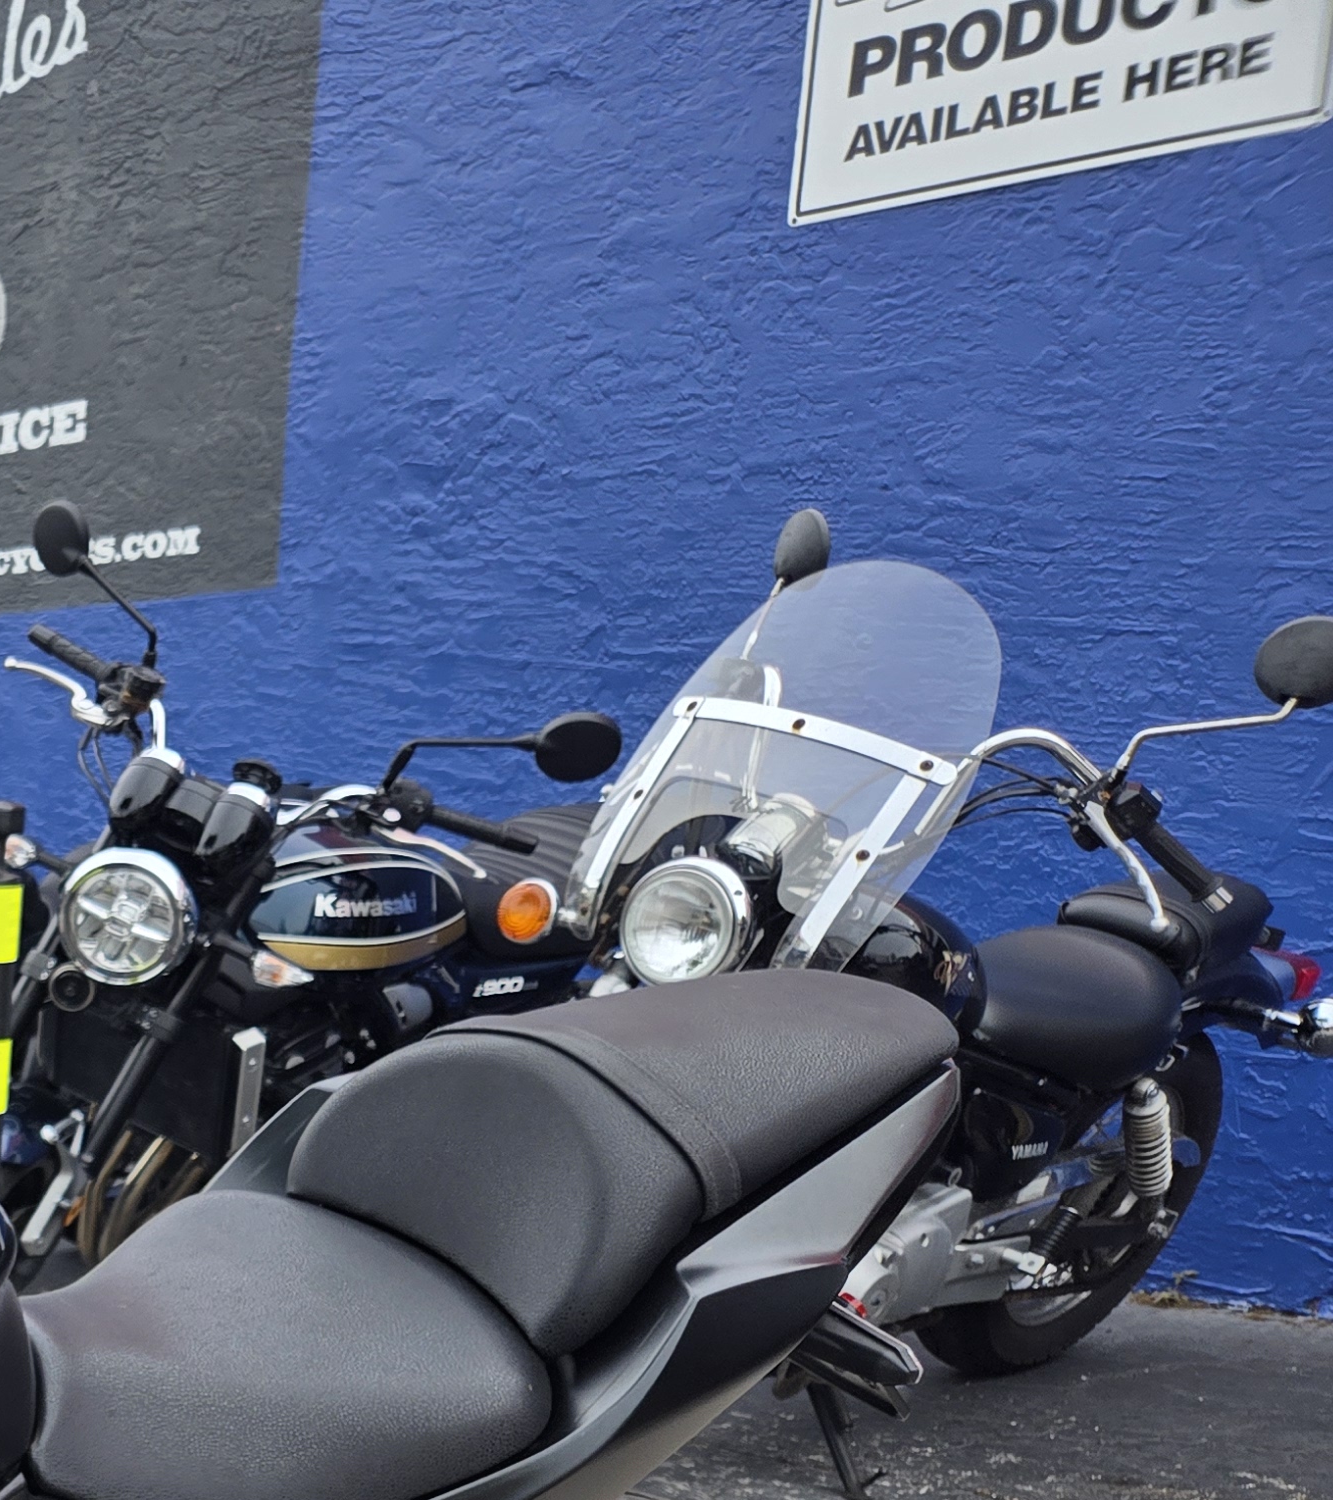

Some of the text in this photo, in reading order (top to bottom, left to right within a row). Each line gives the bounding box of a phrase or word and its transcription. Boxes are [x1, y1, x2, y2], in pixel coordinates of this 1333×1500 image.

[842, 32, 1274, 163] AVAILABLE HERE
[314, 891, 417, 919] Kawasaki
